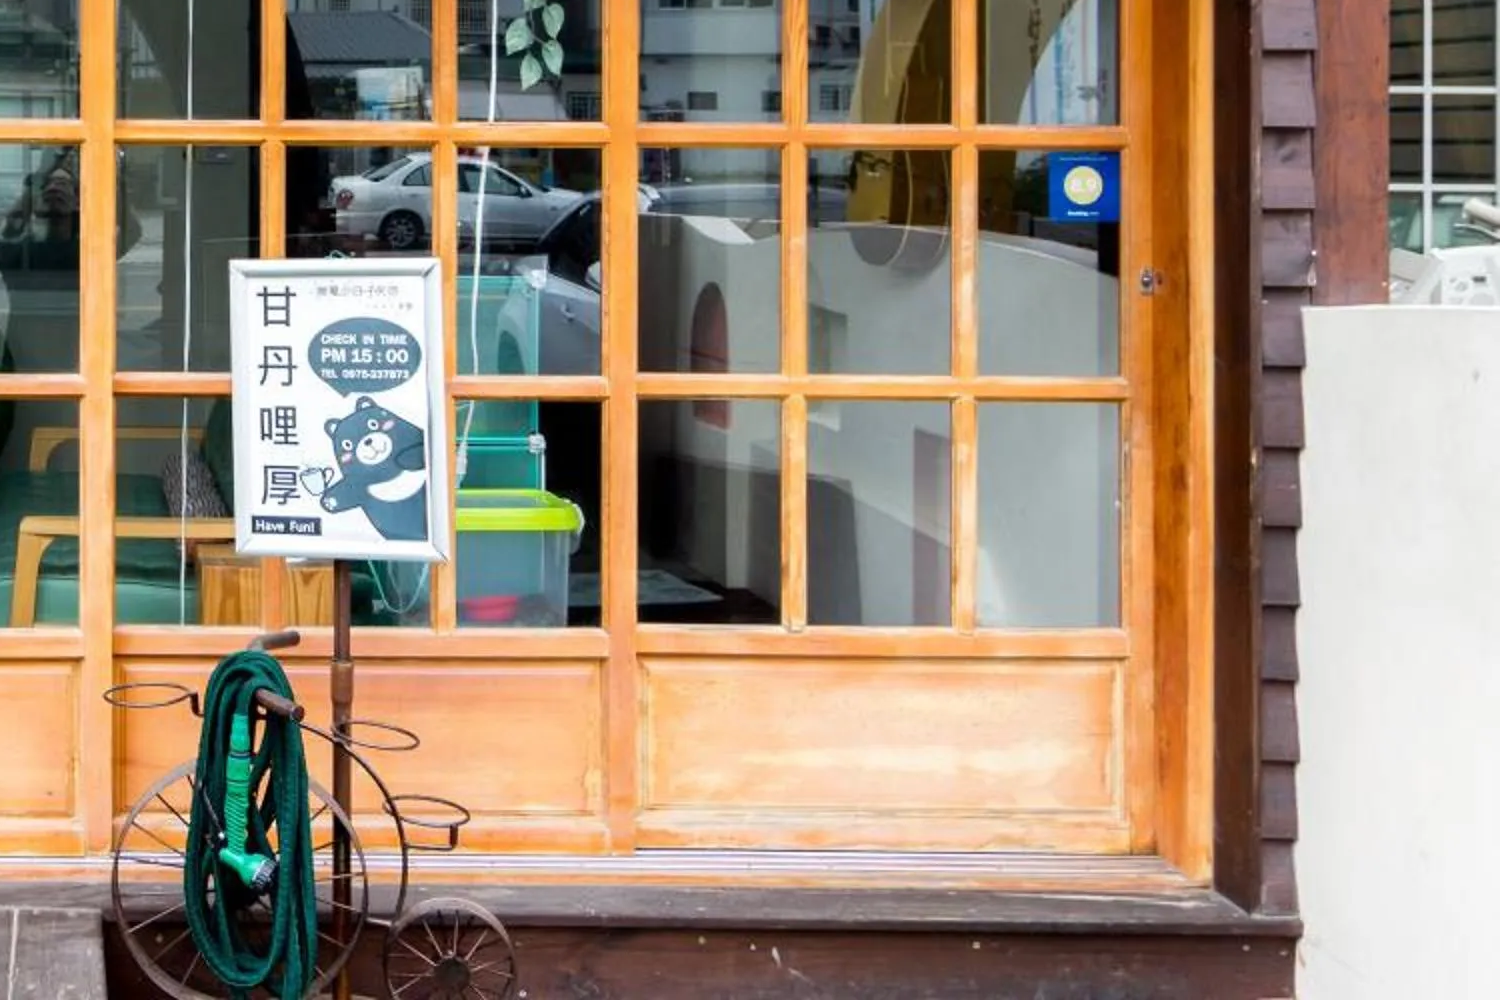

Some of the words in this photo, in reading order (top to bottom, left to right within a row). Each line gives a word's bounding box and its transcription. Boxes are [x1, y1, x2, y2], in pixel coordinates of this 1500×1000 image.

[321, 333, 357, 345] CHECK
[362, 334, 375, 345] IN
[380, 334, 408, 345] TIME
[321, 348, 347, 364] PM
[256, 286, 302, 506] 甘丹哩厚
[255, 519, 285, 533] Have
